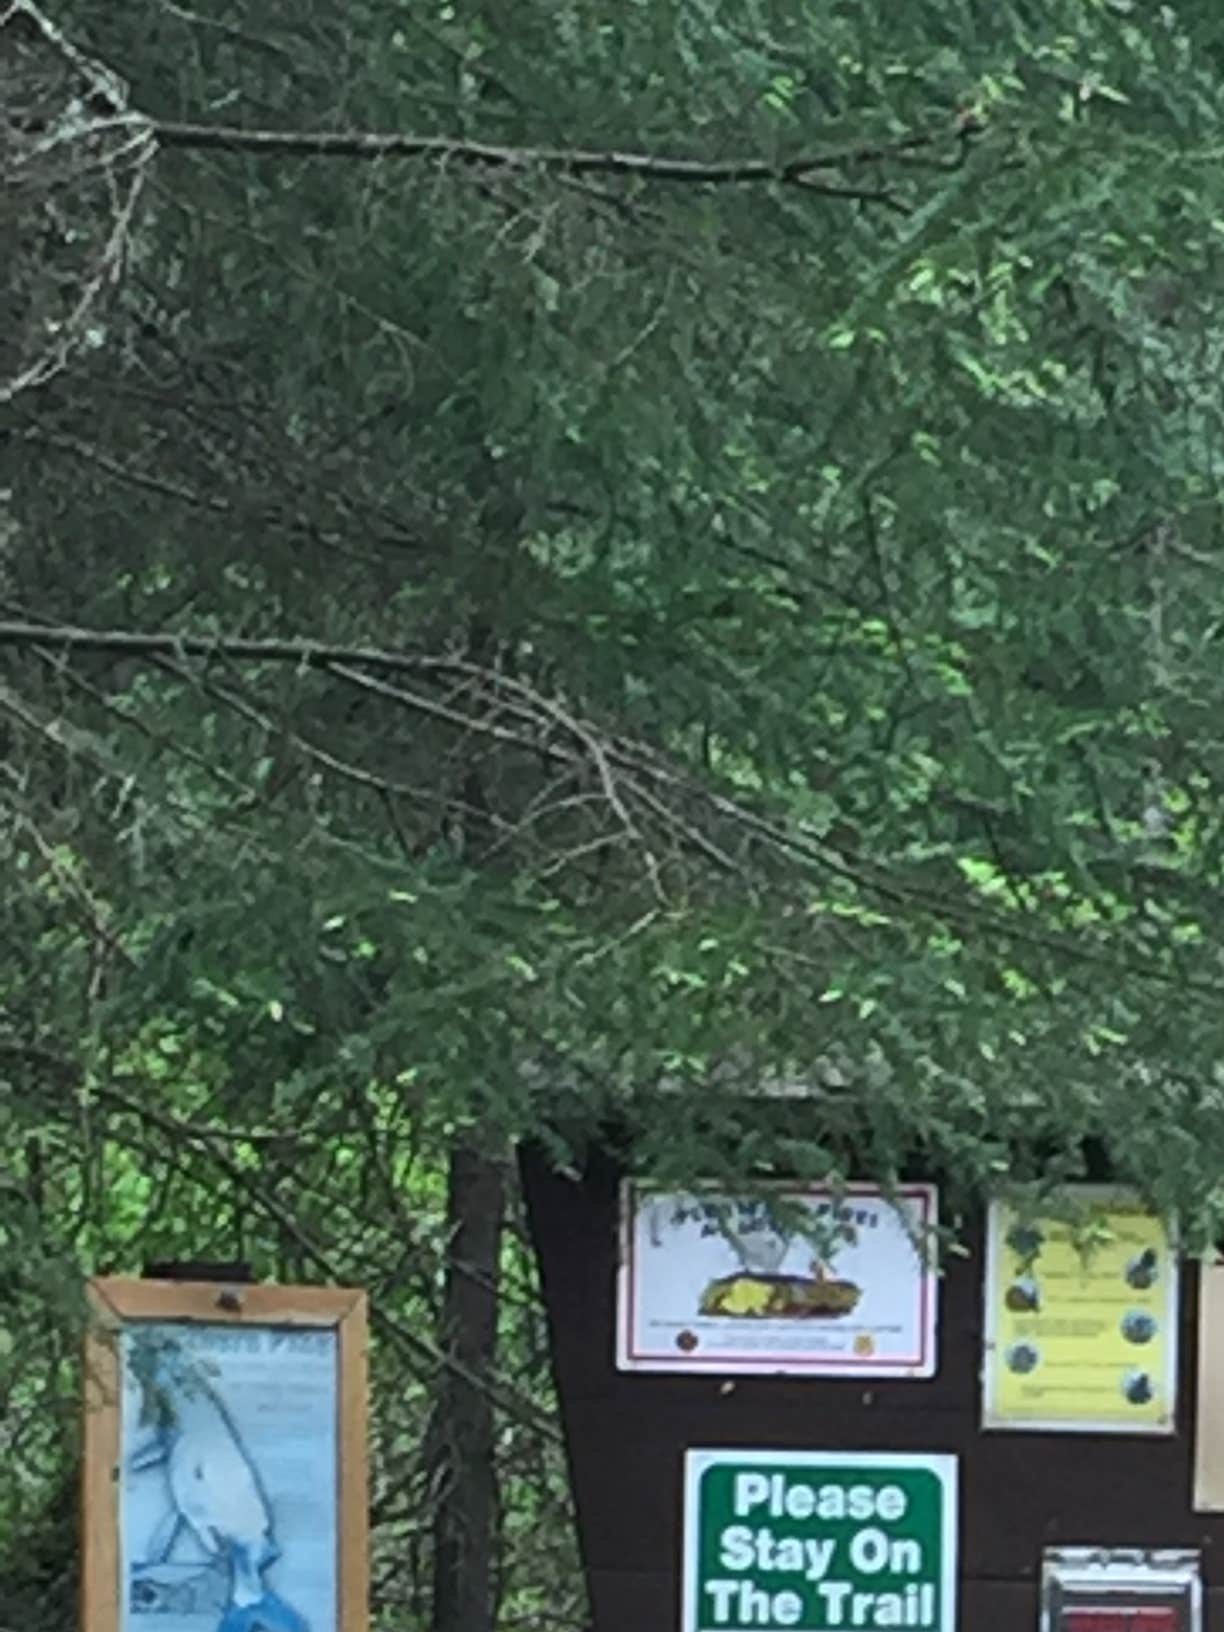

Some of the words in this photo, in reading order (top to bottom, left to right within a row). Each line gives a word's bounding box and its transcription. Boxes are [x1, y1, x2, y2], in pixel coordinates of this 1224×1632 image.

[735, 1473, 908, 1520] Please
[720, 1525, 837, 1581] Stay
[850, 1527, 922, 1574] On
[704, 1579, 804, 1625] The
[817, 1581, 936, 1627] Trail
